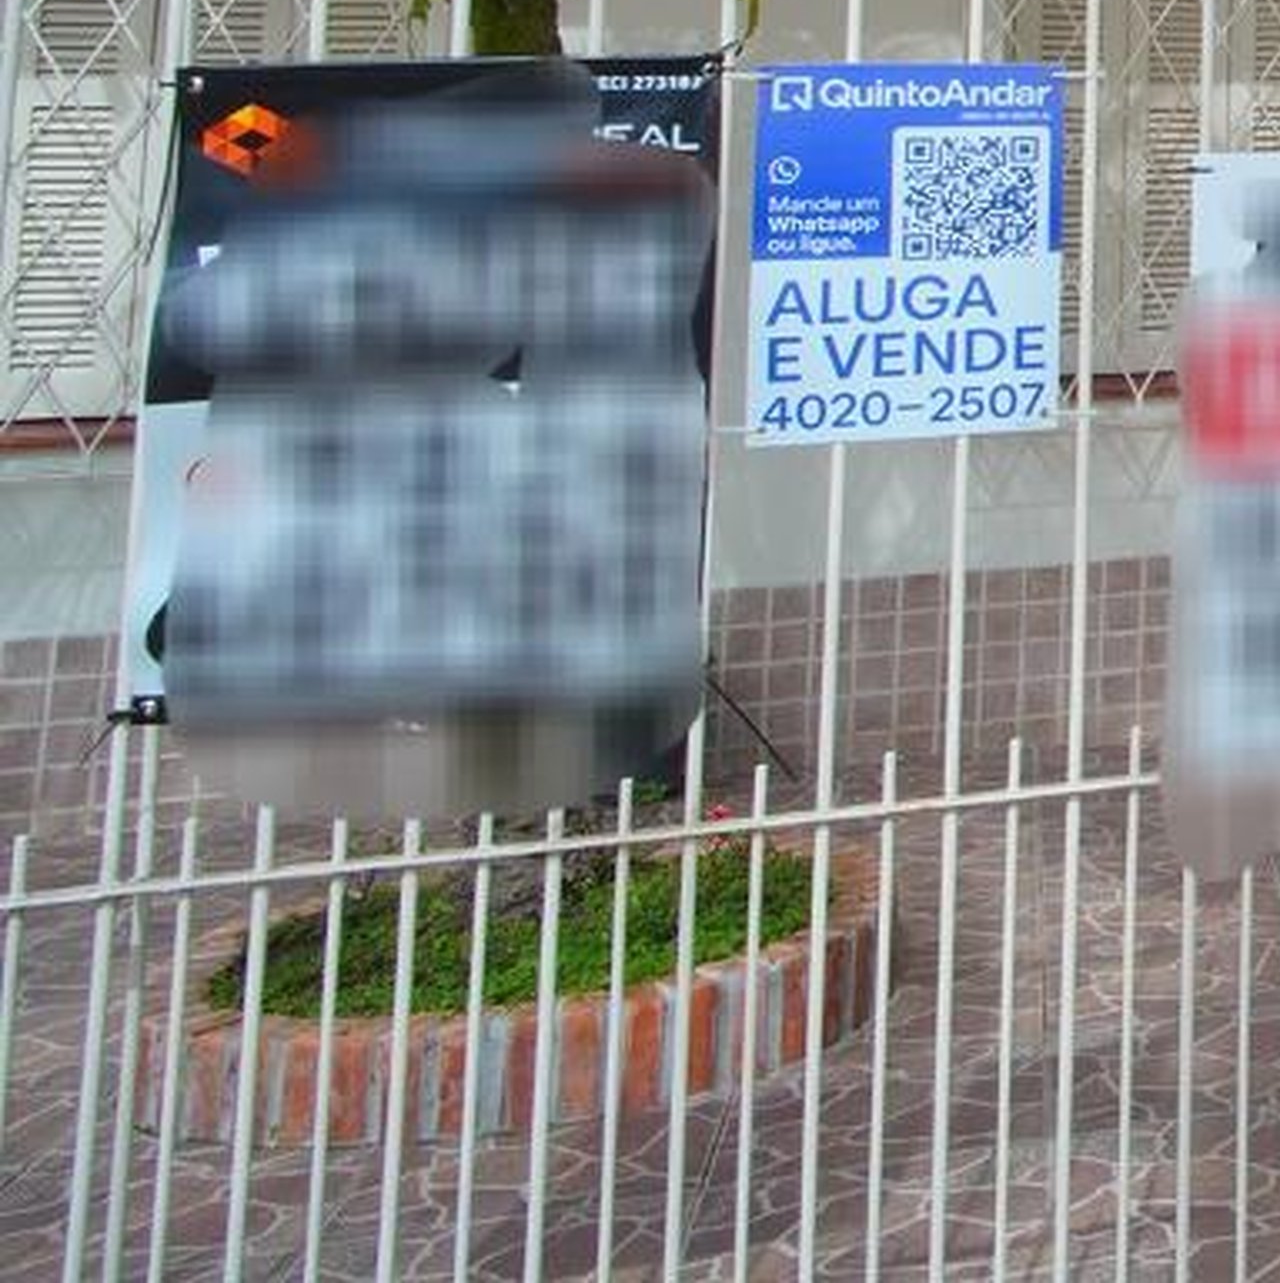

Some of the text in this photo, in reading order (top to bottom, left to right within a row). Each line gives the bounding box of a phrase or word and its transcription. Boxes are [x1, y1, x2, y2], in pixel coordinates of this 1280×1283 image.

[819, 78, 1051, 109] QuintoAndar
[846, 198, 880, 211] um
[767, 239, 797, 253] ou
[765, 274, 998, 326] ALUGA
[767, 326, 1046, 383] E VENDE
[762, 383, 1045, 431] 4020-2507
